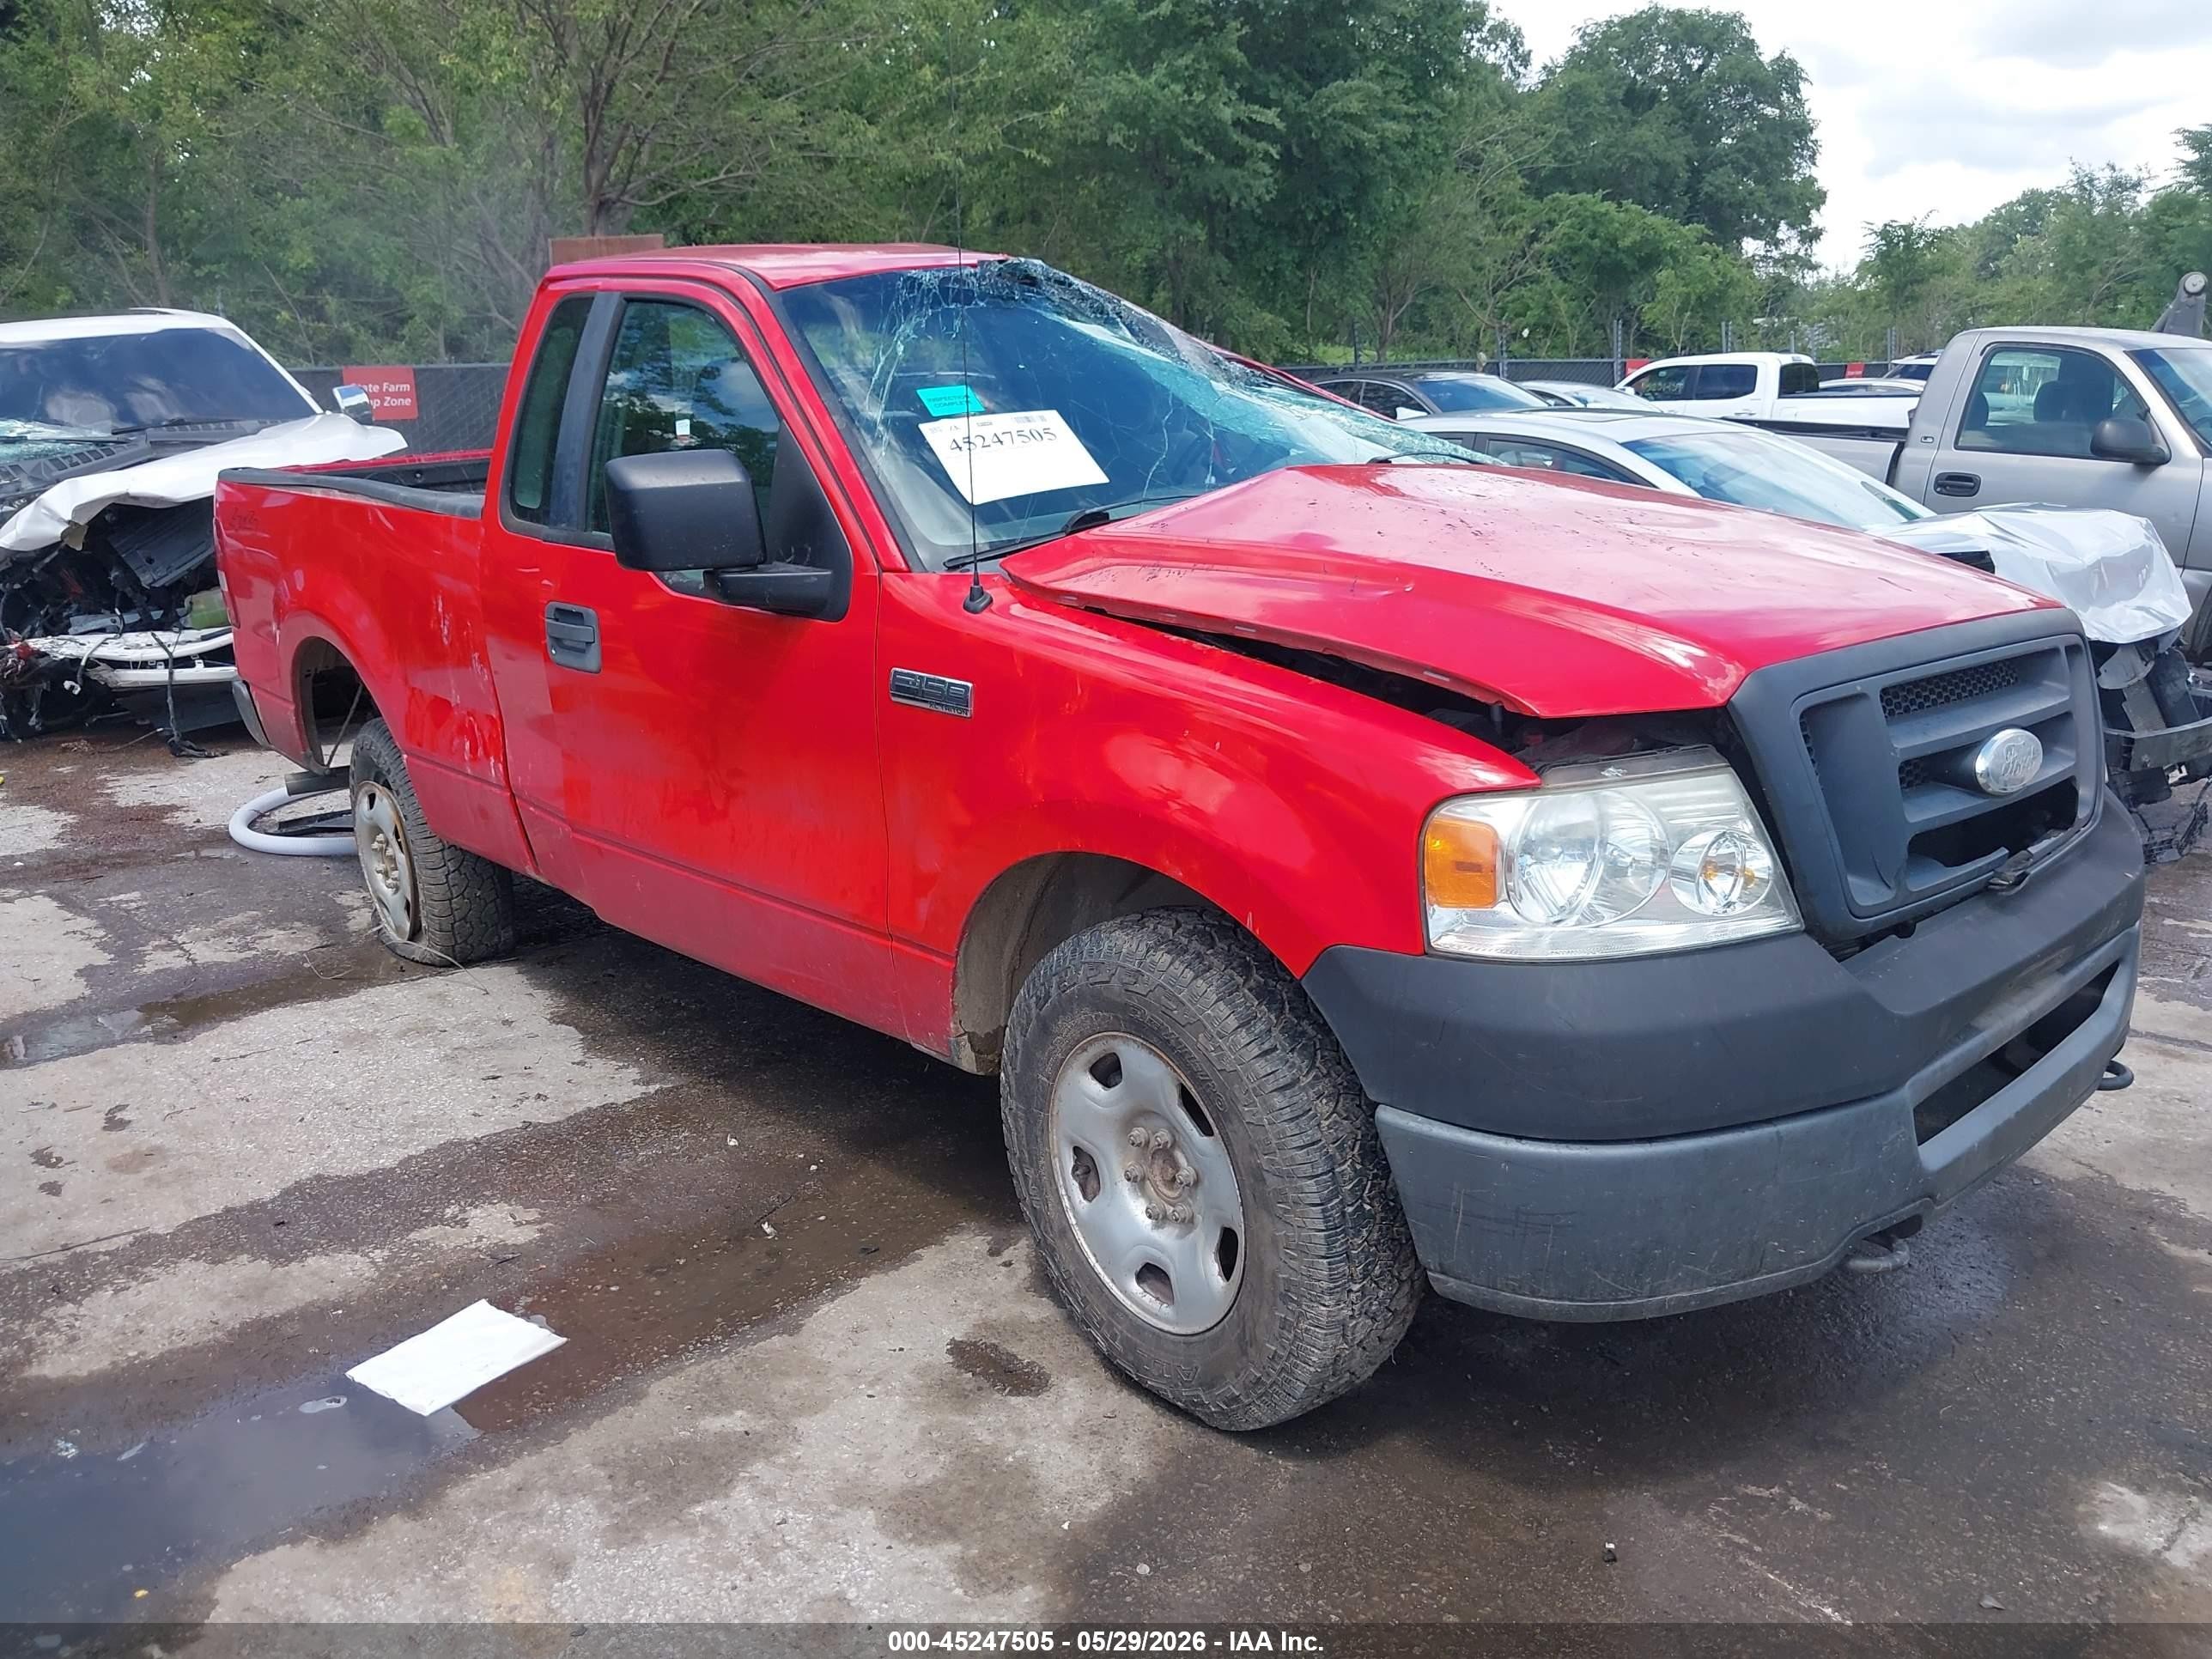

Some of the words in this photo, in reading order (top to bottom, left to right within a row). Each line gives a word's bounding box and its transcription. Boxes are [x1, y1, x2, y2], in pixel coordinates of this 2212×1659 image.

[383, 382, 410, 392] Farm
[384, 397, 411, 406] Zone
[950, 428, 1057, 451] 45247505
[2001, 740, 2035, 776] Ford
